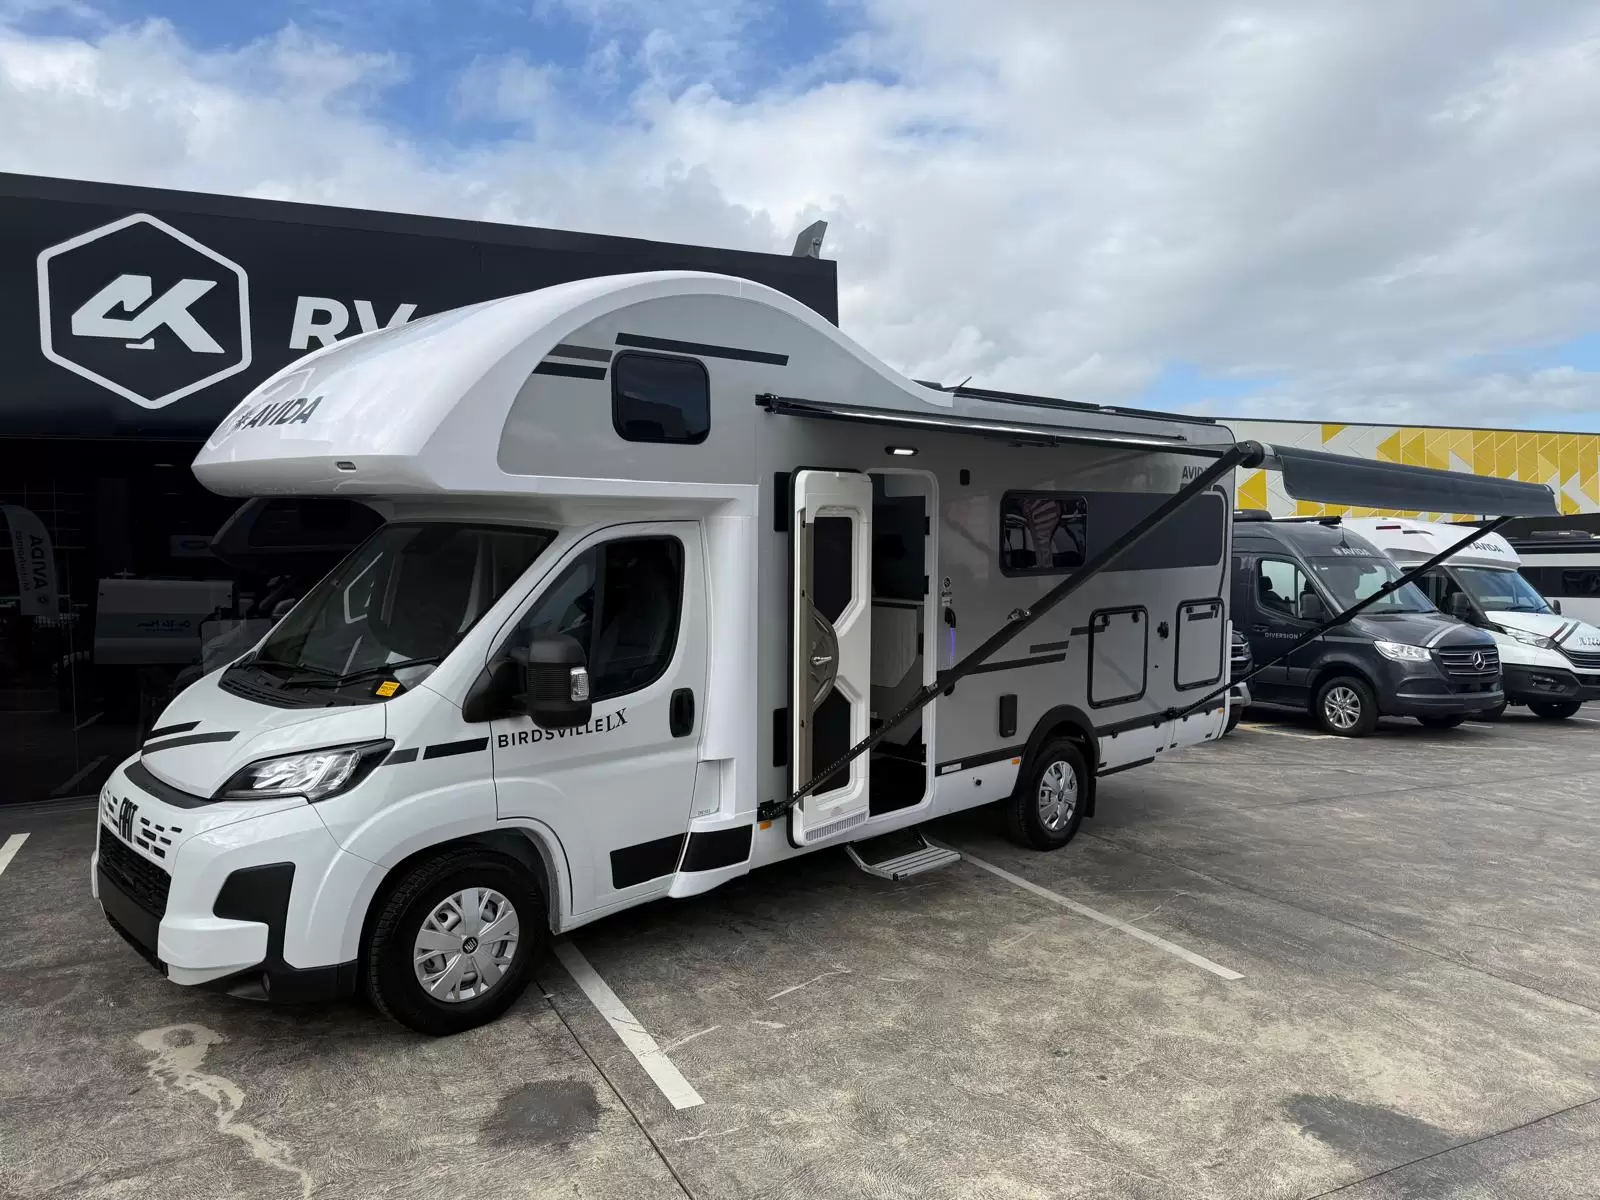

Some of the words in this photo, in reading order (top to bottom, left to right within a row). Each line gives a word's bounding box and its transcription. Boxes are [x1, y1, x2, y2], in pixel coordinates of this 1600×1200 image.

[240, 395, 325, 431] AVIDA
[1472, 542, 1505, 554] AVIDA
[1264, 632, 1299, 640] DIVERSION
[498, 719, 604, 748] BIRDSVILLE
